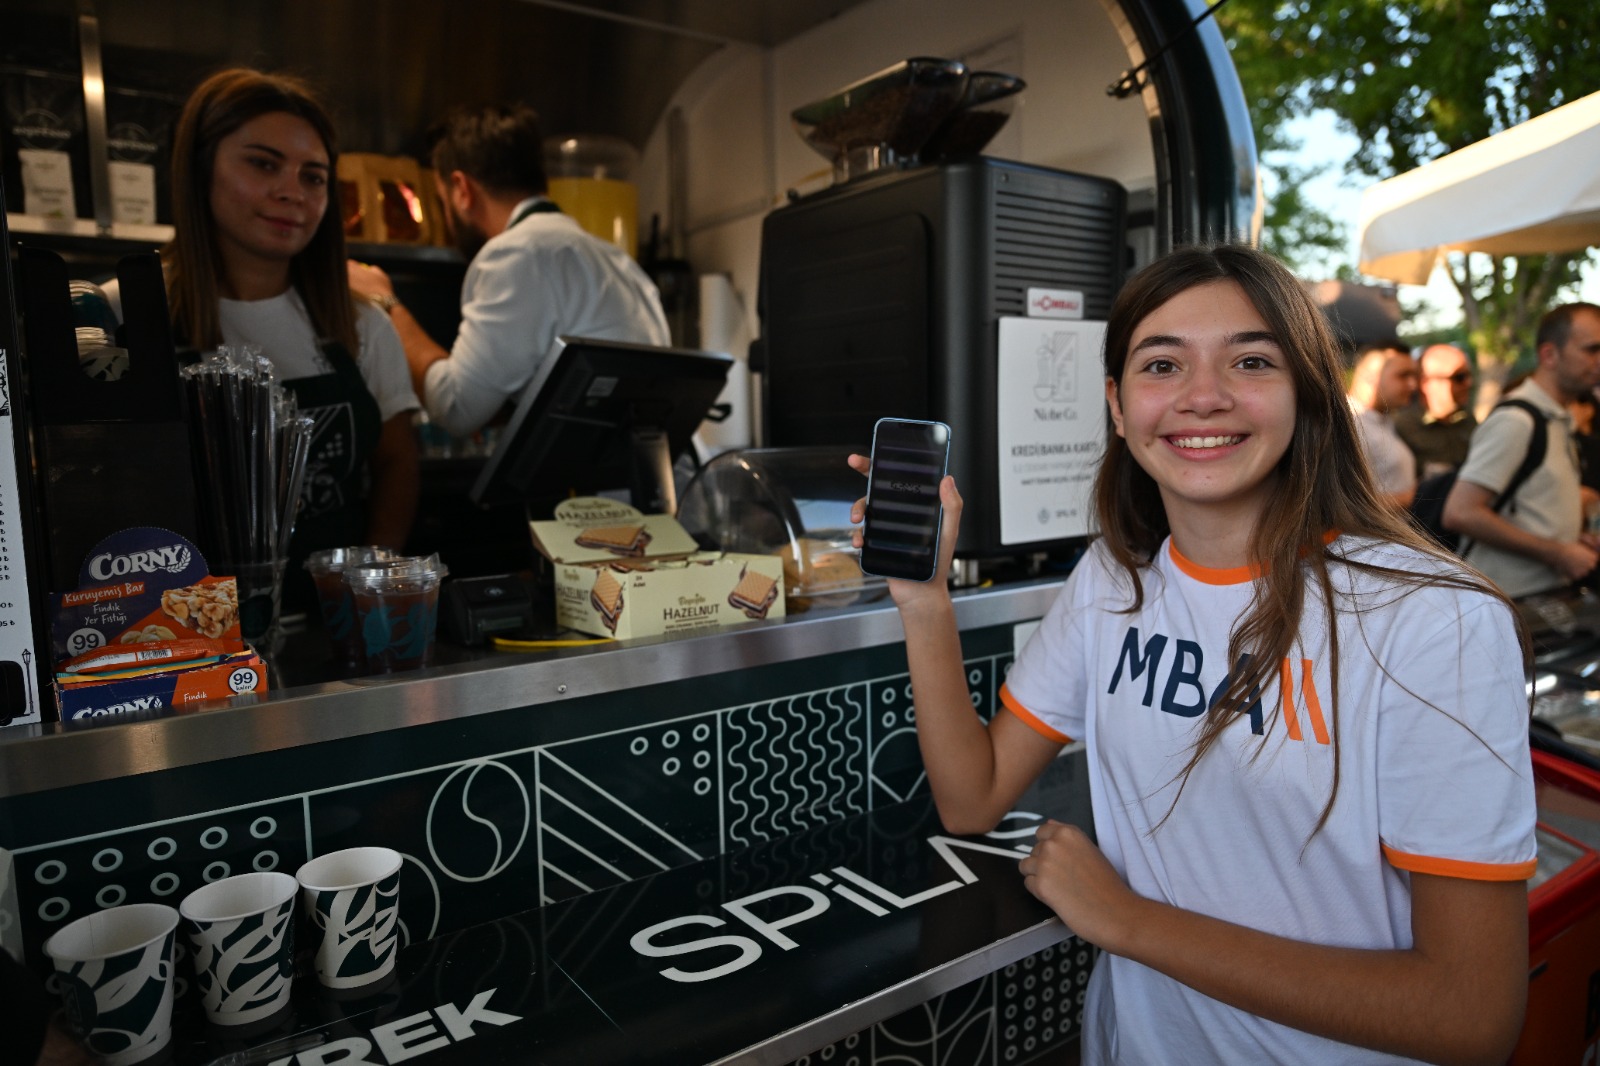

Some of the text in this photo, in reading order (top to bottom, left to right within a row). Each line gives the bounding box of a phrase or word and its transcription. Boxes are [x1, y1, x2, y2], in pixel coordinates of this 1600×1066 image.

[89, 545, 184, 581] CORNY
[64, 582, 144, 604] Kuruyemiş Bar
[663, 603, 720, 620] HAZELNUT
[85, 616, 98, 626] Yer
[73, 633, 100, 650] 99
[233, 672, 253, 686] 99
[266, 987, 524, 1066] REK
